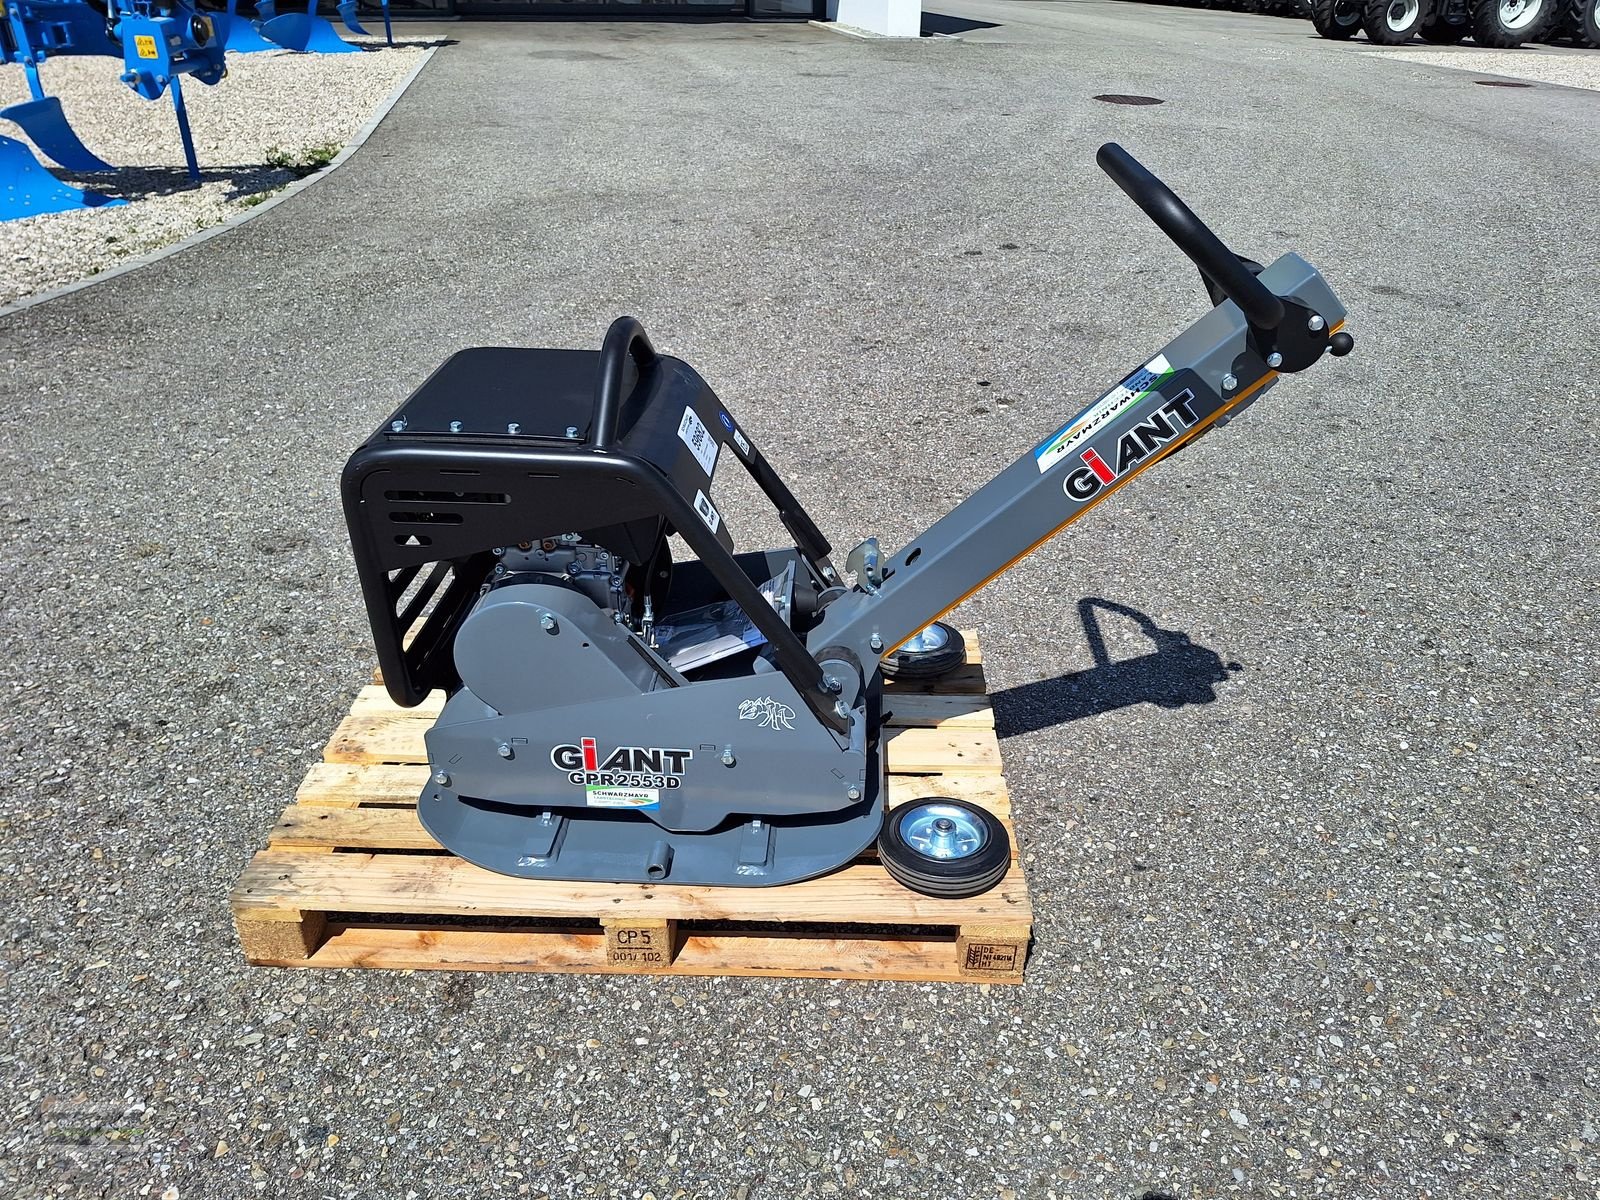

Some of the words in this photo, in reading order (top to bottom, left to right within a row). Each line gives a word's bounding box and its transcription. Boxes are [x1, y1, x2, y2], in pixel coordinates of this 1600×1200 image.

[1056, 374, 1159, 454] SCHWARZMAYR
[568, 771, 681, 789] GPR2553D
[592, 790, 649, 798] SCHWARZMAYR
[617, 930, 638, 944] CP
[640, 930, 651, 944] 5
[641, 952, 661, 962] 102
